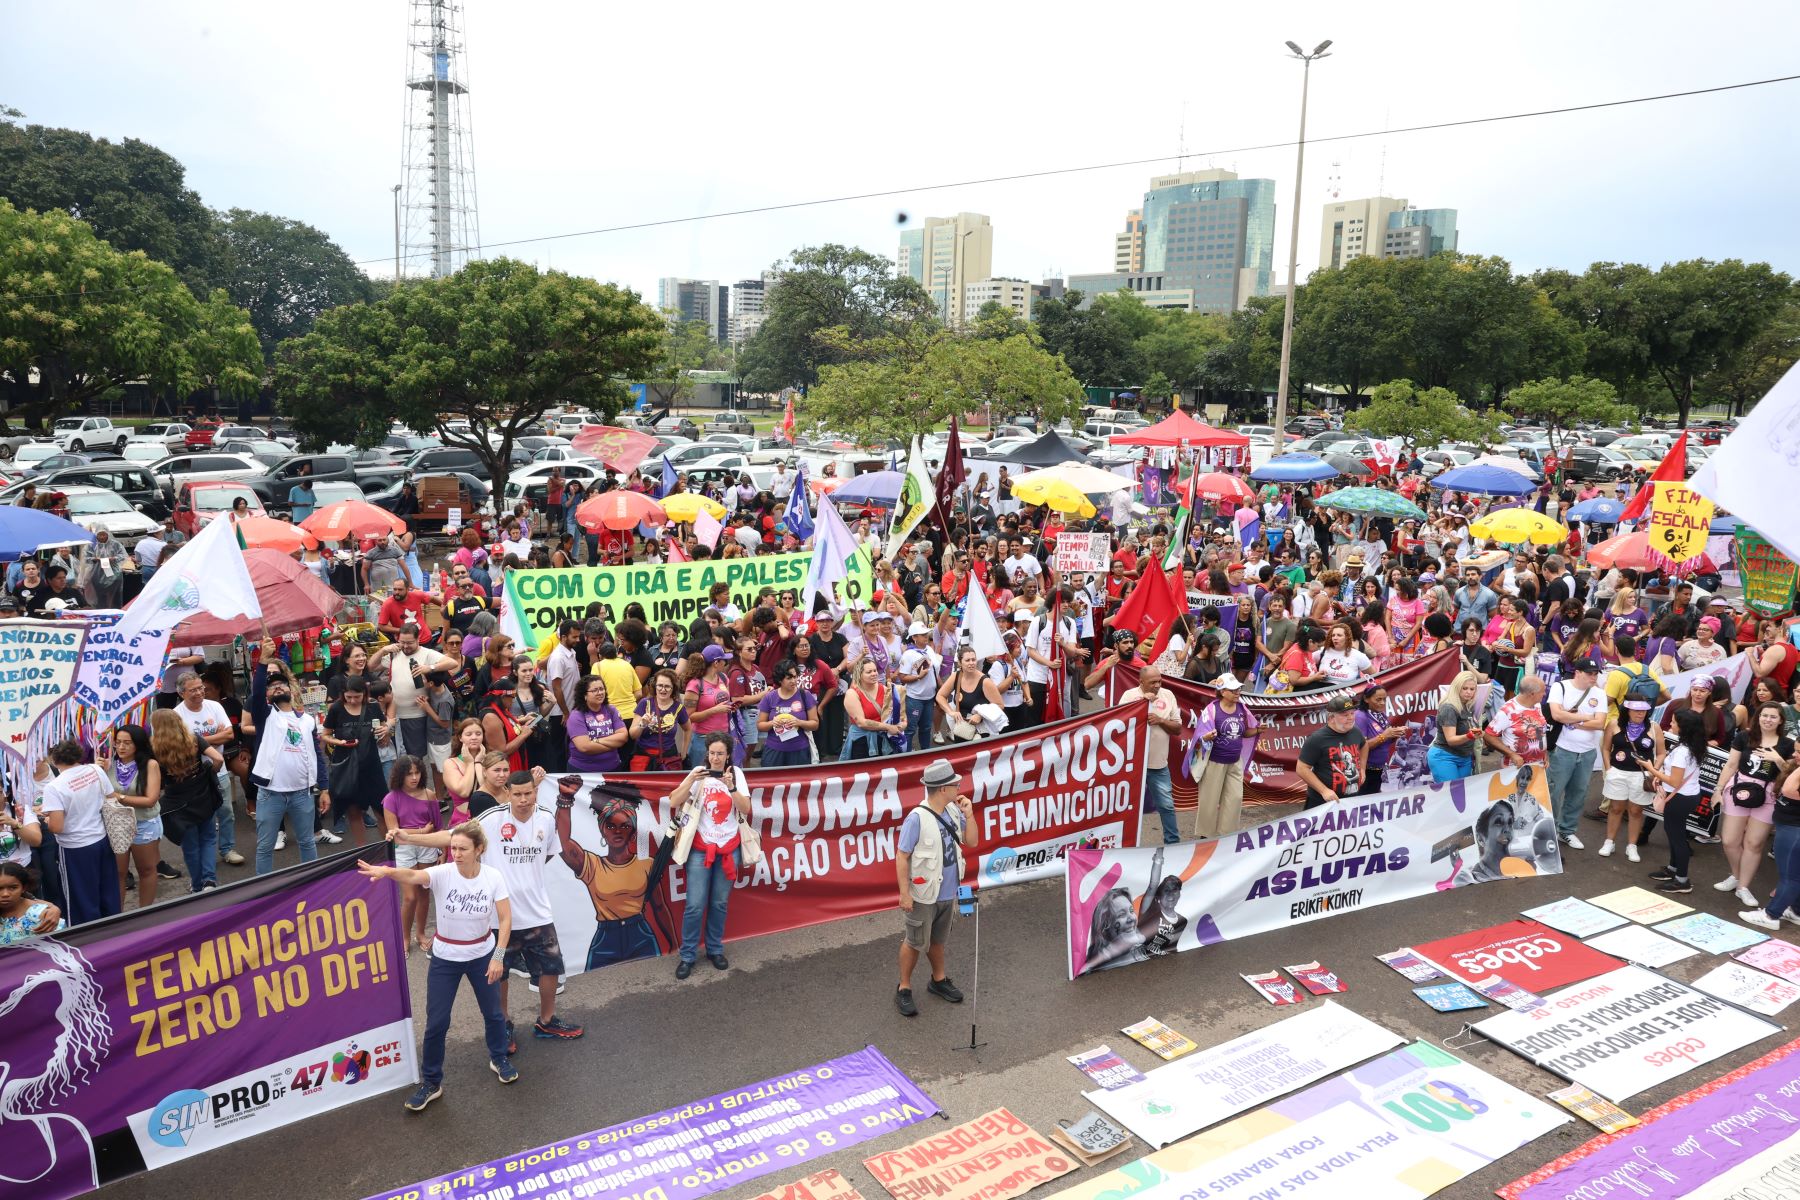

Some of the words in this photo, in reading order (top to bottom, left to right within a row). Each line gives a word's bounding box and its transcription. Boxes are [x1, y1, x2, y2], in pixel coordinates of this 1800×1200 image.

[1666, 488, 1703, 507] FIM
[1651, 510, 1710, 530] ESCALA
[1059, 541, 1089, 552] TEMPO
[1073, 533, 1089, 541] MAIS
[517, 572, 583, 600] COM
[593, 572, 616, 596] O
[625, 565, 668, 596] IRÃ
[676, 567, 692, 593] E
[699, 564, 723, 589] A
[727, 552, 861, 588] PALESTA
[1058, 559, 1095, 571] FAMÍLIA
[1187, 596, 1207, 607] ABORTO
[525, 603, 617, 630] CONTA
[0, 630, 76, 646] NGIDAS
[40, 648, 79, 664] POR
[1386, 689, 1440, 717] ASCISM
[637, 767, 903, 861] NHUMA
[972, 717, 1137, 804] MENOS!
[1235, 831, 1255, 852] A
[1258, 794, 1425, 849] PARLAMENTAR
[503, 845, 543, 856] Emirates
[669, 833, 830, 902] ECAÇÃO
[838, 826, 902, 869] CON
[983, 780, 1134, 842] FEMINICÍDIO.
[1277, 842, 1305, 868] DE
[1313, 828, 1384, 861] TODAS
[991, 849, 1046, 873] SINPRO
[1245, 869, 1298, 902] AS
[1300, 847, 1409, 889] LUTAS
[445, 904, 456, 913] as
[446, 889, 488, 905] Respeita
[1326, 888, 1363, 911] KOKAY
[124, 898, 371, 1008] FEMINICÍDIO
[1458, 938, 1562, 974] cebes
[130, 985, 243, 1058] ZERO
[253, 965, 311, 1018] NO
[321, 941, 389, 999] DF!!
[1556, 985, 1614, 1009] NÚCLEO
[1580, 982, 1689, 1027] DEMOCRACIA
[1529, 1008, 1551, 1020] DF
[1510, 1024, 1582, 1057] SAÚDE!
[1547, 1022, 1666, 1075] DEMOCRACIA
[1643, 1038, 1706, 1068] cebes
[1232, 1042, 1291, 1075] SOBERANIA
[1274, 1055, 1299, 1076] POR
[815, 1067, 833, 1081] O
[1221, 1065, 1276, 1091] DIREITOS
[1249, 1079, 1267, 1095] EM
[158, 1080, 271, 1138] SINPRO
[272, 1086, 287, 1101] DF
[290, 1060, 329, 1092] 47
[302, 1085, 322, 1096] anos
[719, 1072, 813, 1109] SINTFUB
[823, 1085, 901, 1115] Mulheres
[1220, 1085, 1250, 1107] LUTA
[597, 1101, 716, 1145] representa
[729, 1097, 802, 1130] Sigamos
[860, 1102, 925, 1129] Viva
[1706, 1094, 1797, 1147] Mundial
[704, 1119, 733, 1138] em
[712, 1109, 827, 1154] trabalhadoras
[815, 1130, 838, 1147] 8
[839, 1122, 856, 1135] o
[903, 1109, 1029, 1169] REFORMA
[1098, 1133, 1125, 1149] BRB
[577, 1139, 592, 1154] e
[617, 1149, 631, 1163] e
[632, 1126, 706, 1161] unidade
[688, 1143, 715, 1163] da
[775, 1138, 811, 1157] de
[1279, 1135, 1326, 1167] FORA
[1361, 1129, 1400, 1158] PELA
[505, 1145, 571, 1173] apoia
[549, 1160, 588, 1183] luta
[588, 1152, 618, 1173] em
[671, 1151, 771, 1189] março,
[1045, 1157, 1069, 1172] O
[1283, 1158, 1320, 1185] DAS
[1319, 1144, 1364, 1174] VIDA
[429, 1170, 476, 1195] luta
[483, 1167, 498, 1180] a
[512, 1166, 548, 1192] por
[572, 1151, 687, 1196] Universidade
[808, 1169, 839, 1190] de
[1207, 1152, 1281, 1195] IBANEIS
